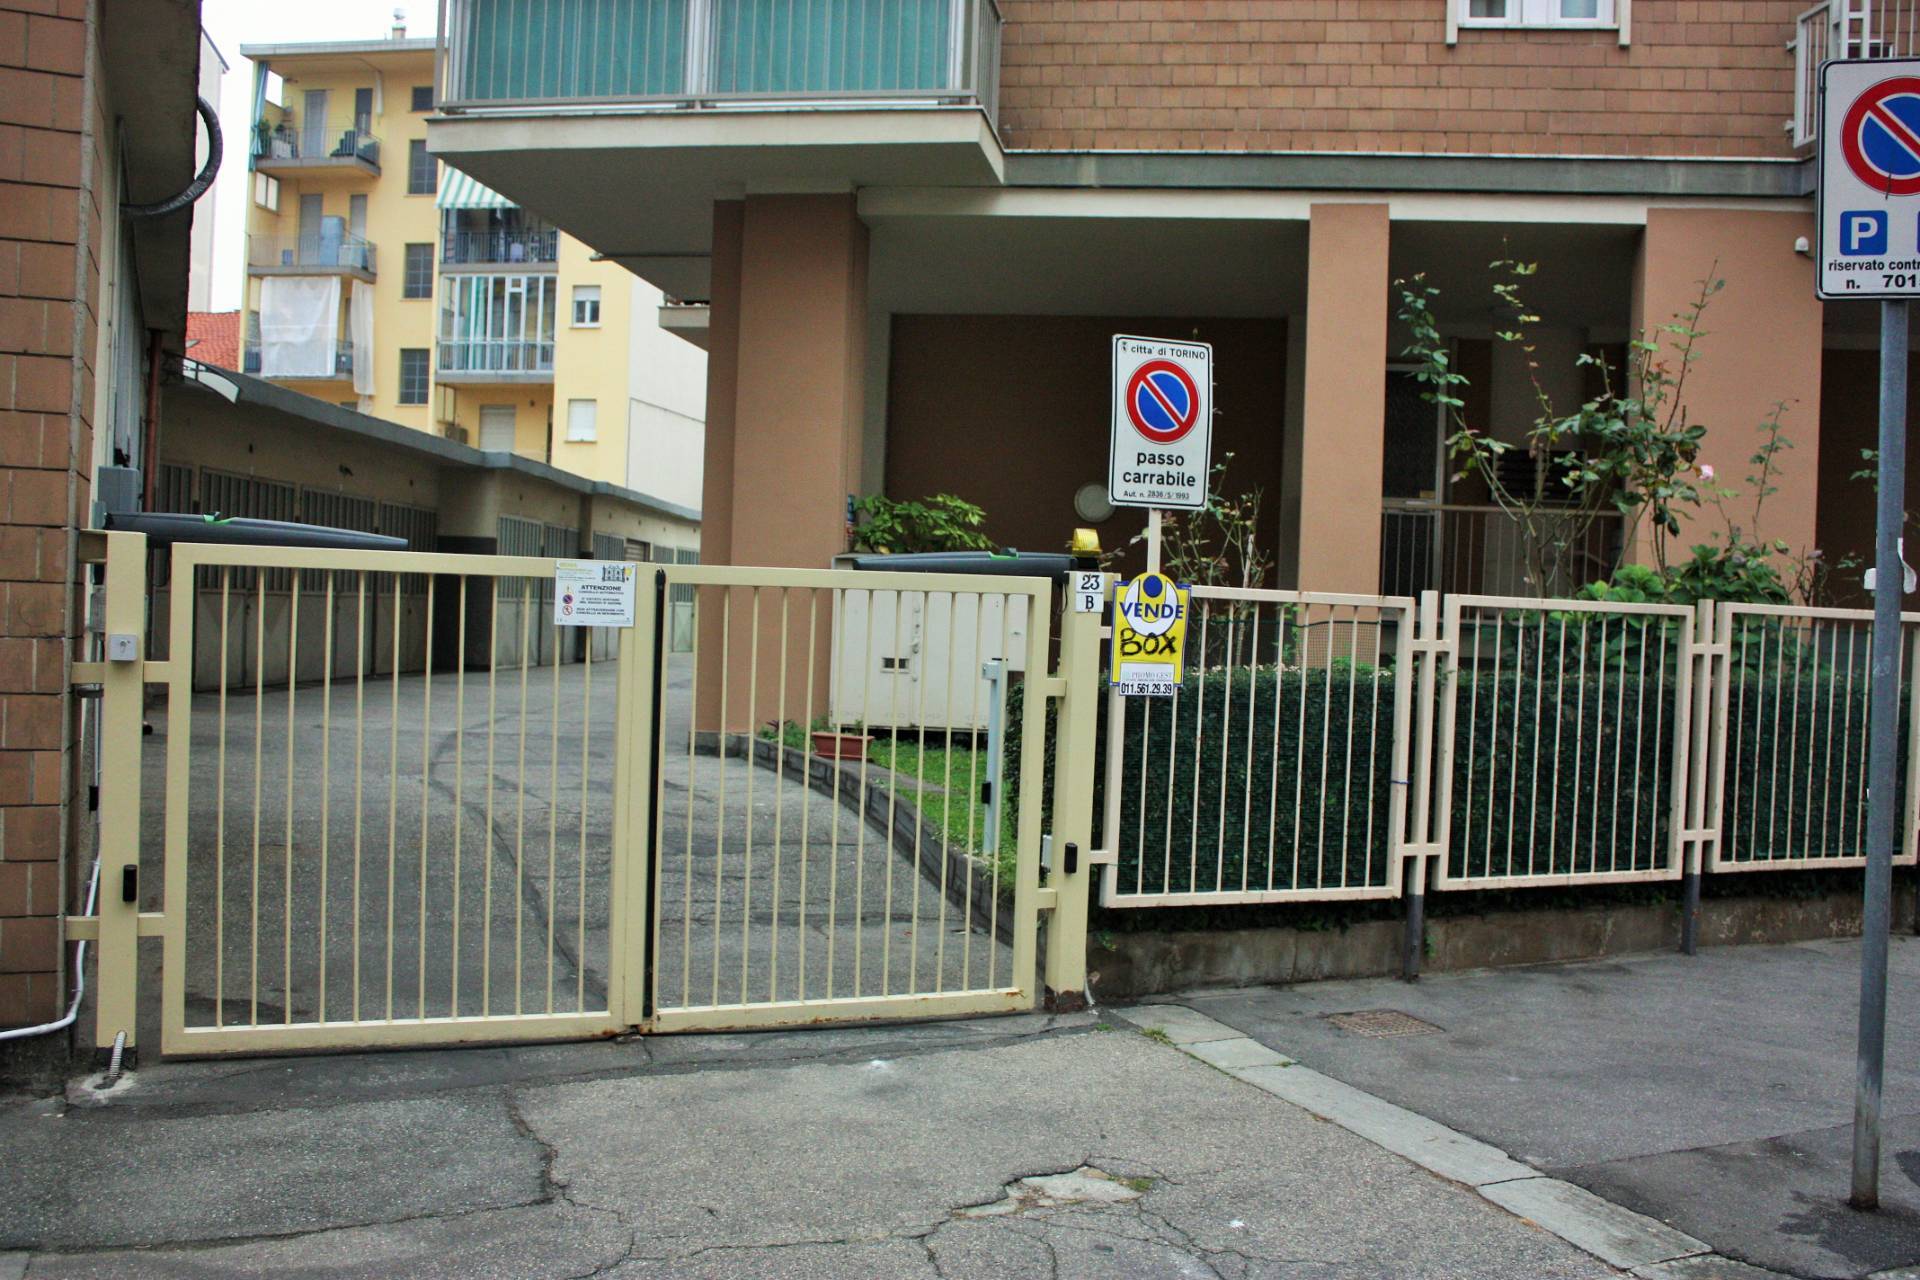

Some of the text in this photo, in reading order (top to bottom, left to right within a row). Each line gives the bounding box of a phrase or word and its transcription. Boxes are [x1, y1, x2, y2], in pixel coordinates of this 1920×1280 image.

[1850, 216, 1878, 250] P
[1828, 259, 1885, 271] riservato
[1845, 273, 1920, 289] n. 701
[1158, 347, 1167, 356] di
[1170, 348, 1206, 360] TORINO
[1136, 451, 1185, 467] passo
[1122, 470, 1196, 487] carrabile
[1081, 574, 1100, 591] 23
[1085, 595, 1095, 610] B
[1119, 602, 1184, 619] VENDE
[1119, 627, 1177, 657] BOX
[1120, 682, 1172, 695] 011.561.29.39
